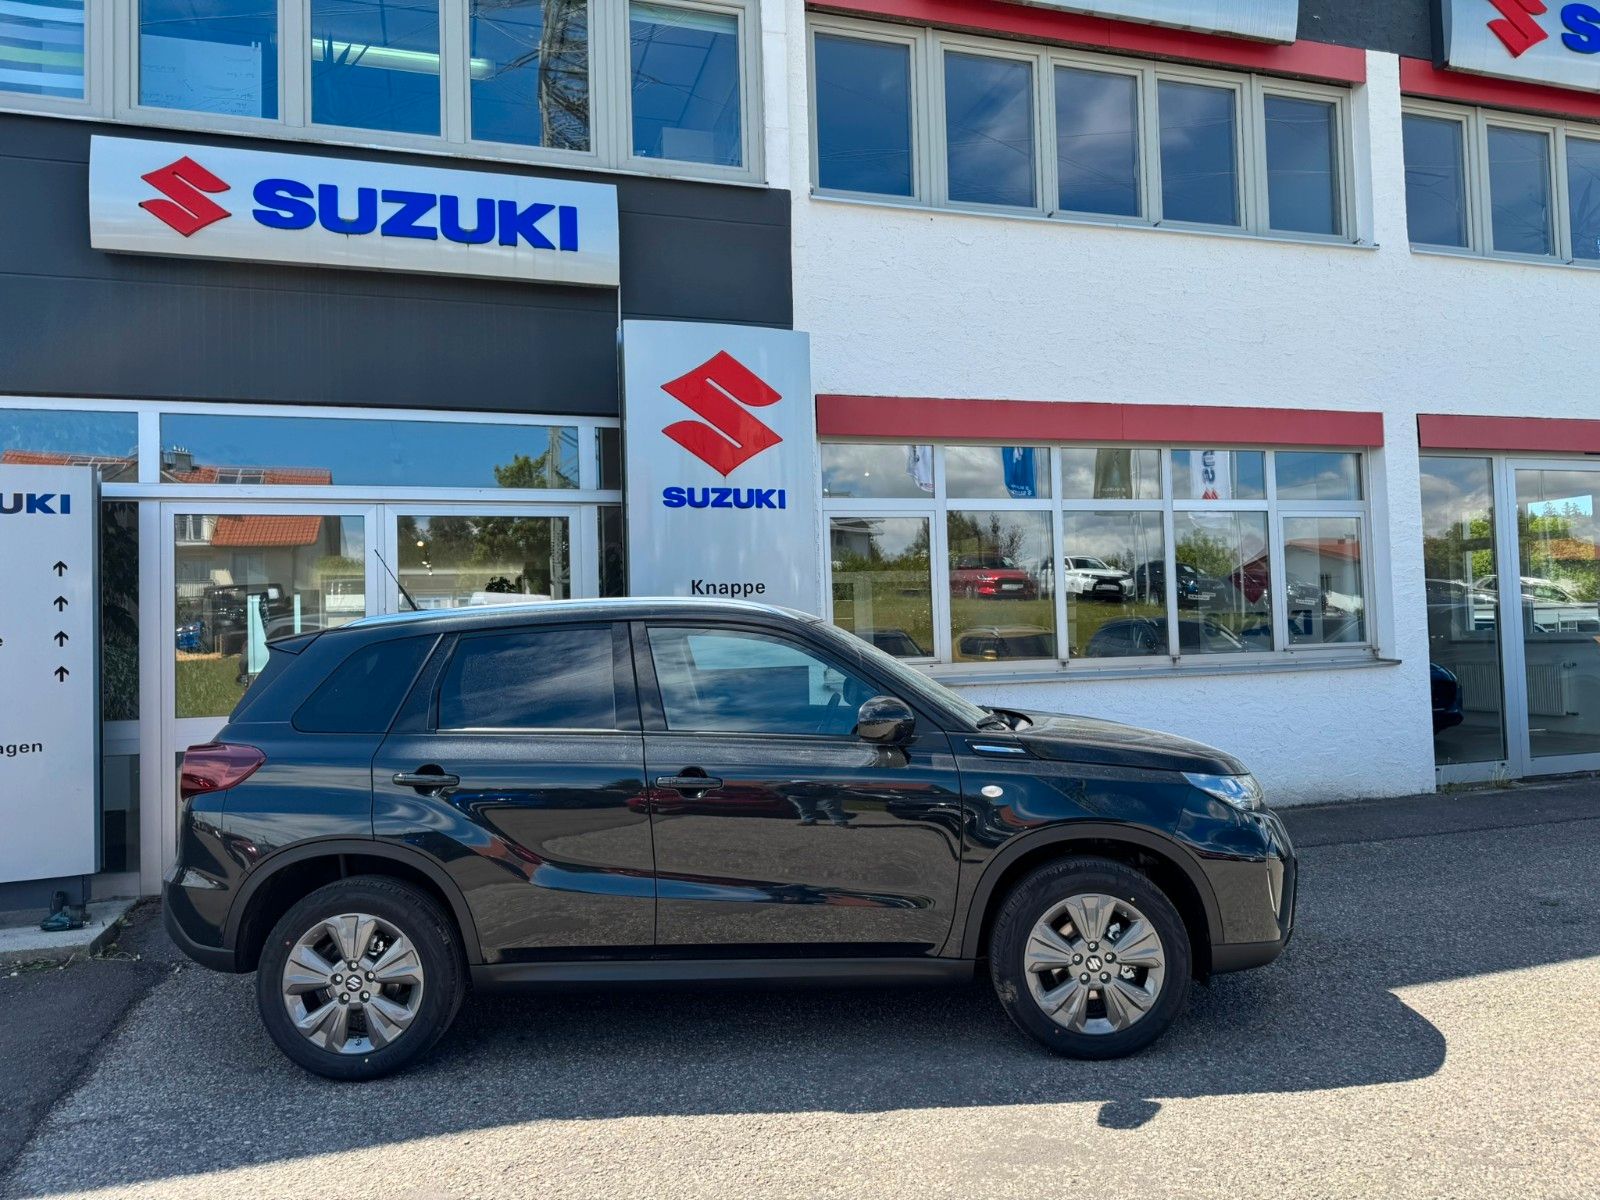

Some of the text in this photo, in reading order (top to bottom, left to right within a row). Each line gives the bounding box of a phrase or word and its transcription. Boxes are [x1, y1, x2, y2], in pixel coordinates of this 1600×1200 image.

[252, 178, 578, 252] SUZUKI
[662, 486, 786, 509] SUZUKI
[691, 579, 766, 598] Knappe
